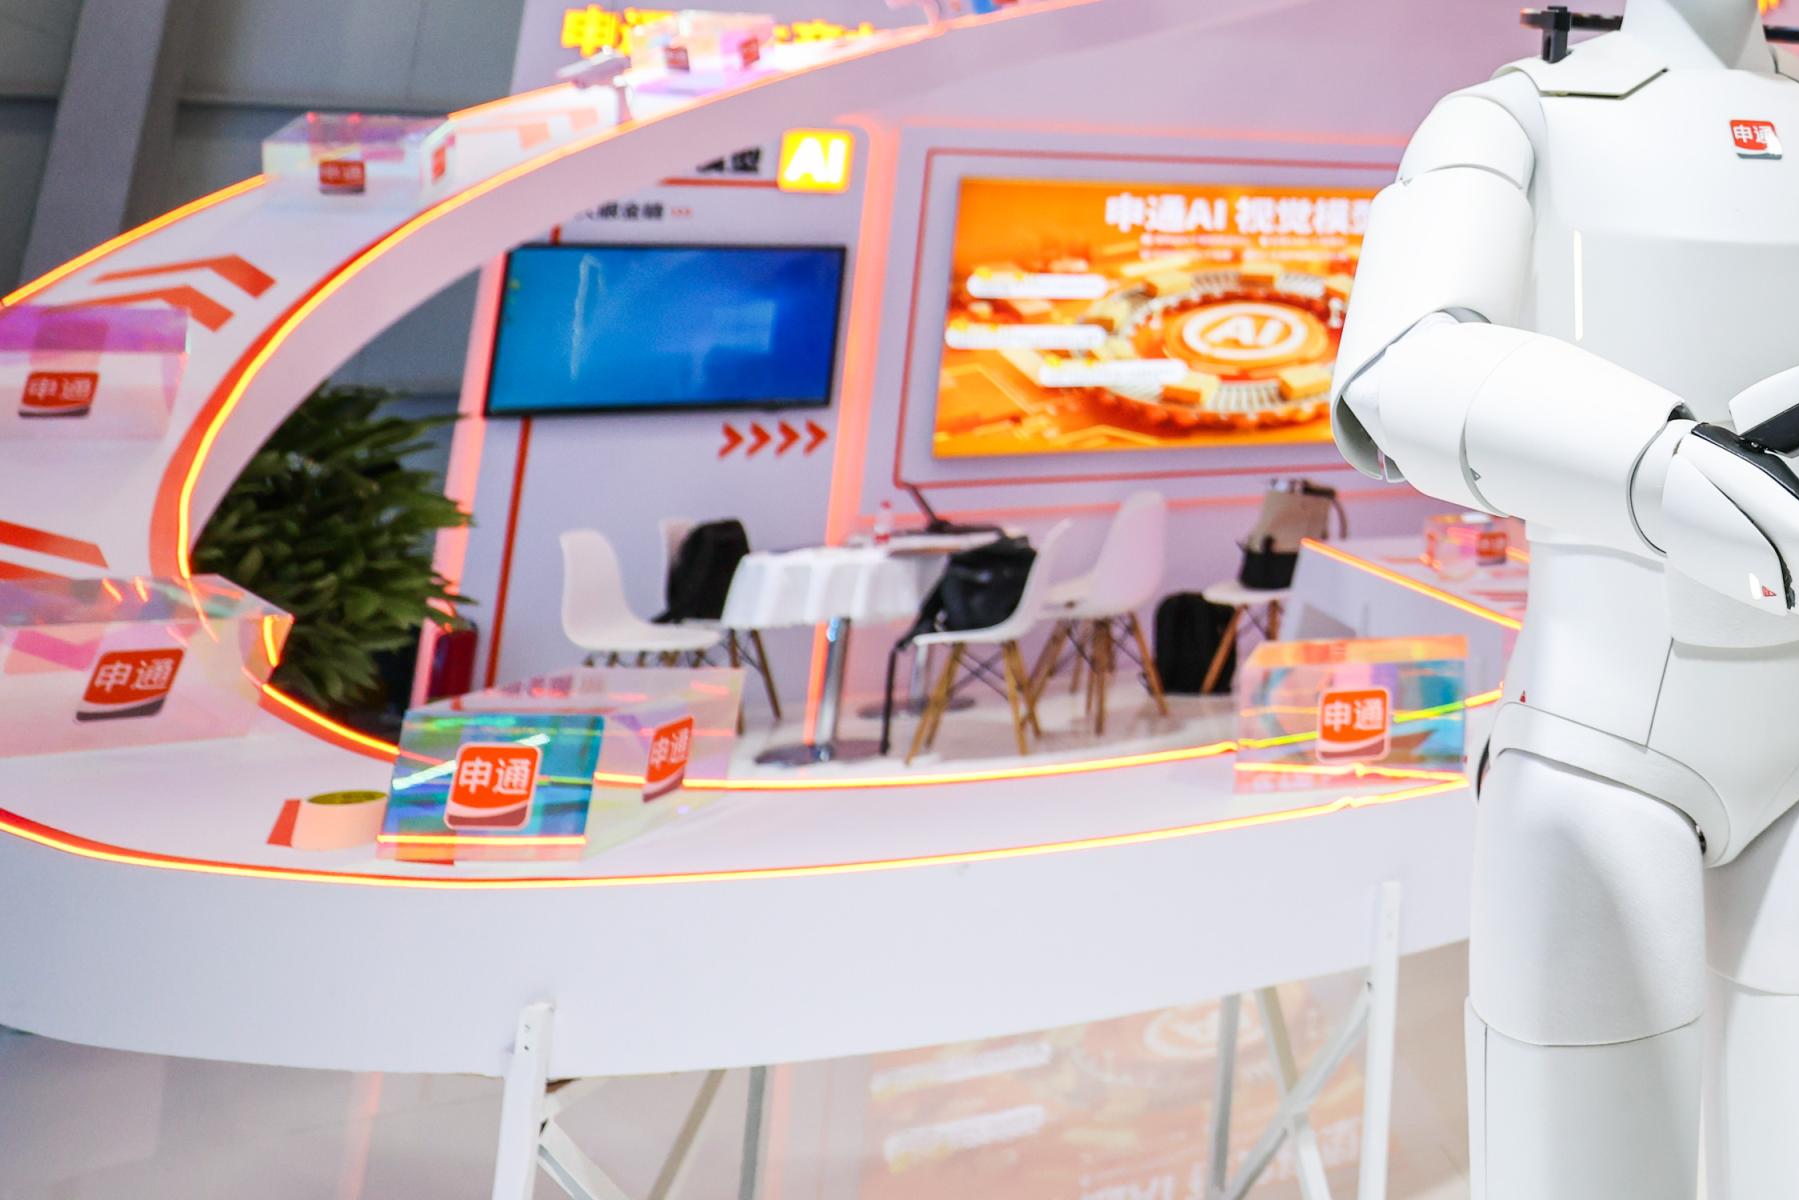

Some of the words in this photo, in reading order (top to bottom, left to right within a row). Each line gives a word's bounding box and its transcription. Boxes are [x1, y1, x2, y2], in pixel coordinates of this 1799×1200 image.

[1733, 124, 1772, 144] 申通
[784, 136, 847, 184] AI
[1206, 316, 1284, 346] AI
[27, 377, 92, 401] 申通
[94, 658, 174, 693] 申通
[1323, 697, 1385, 732] 申通
[651, 728, 689, 769] 申通
[458, 756, 532, 795] 申通
